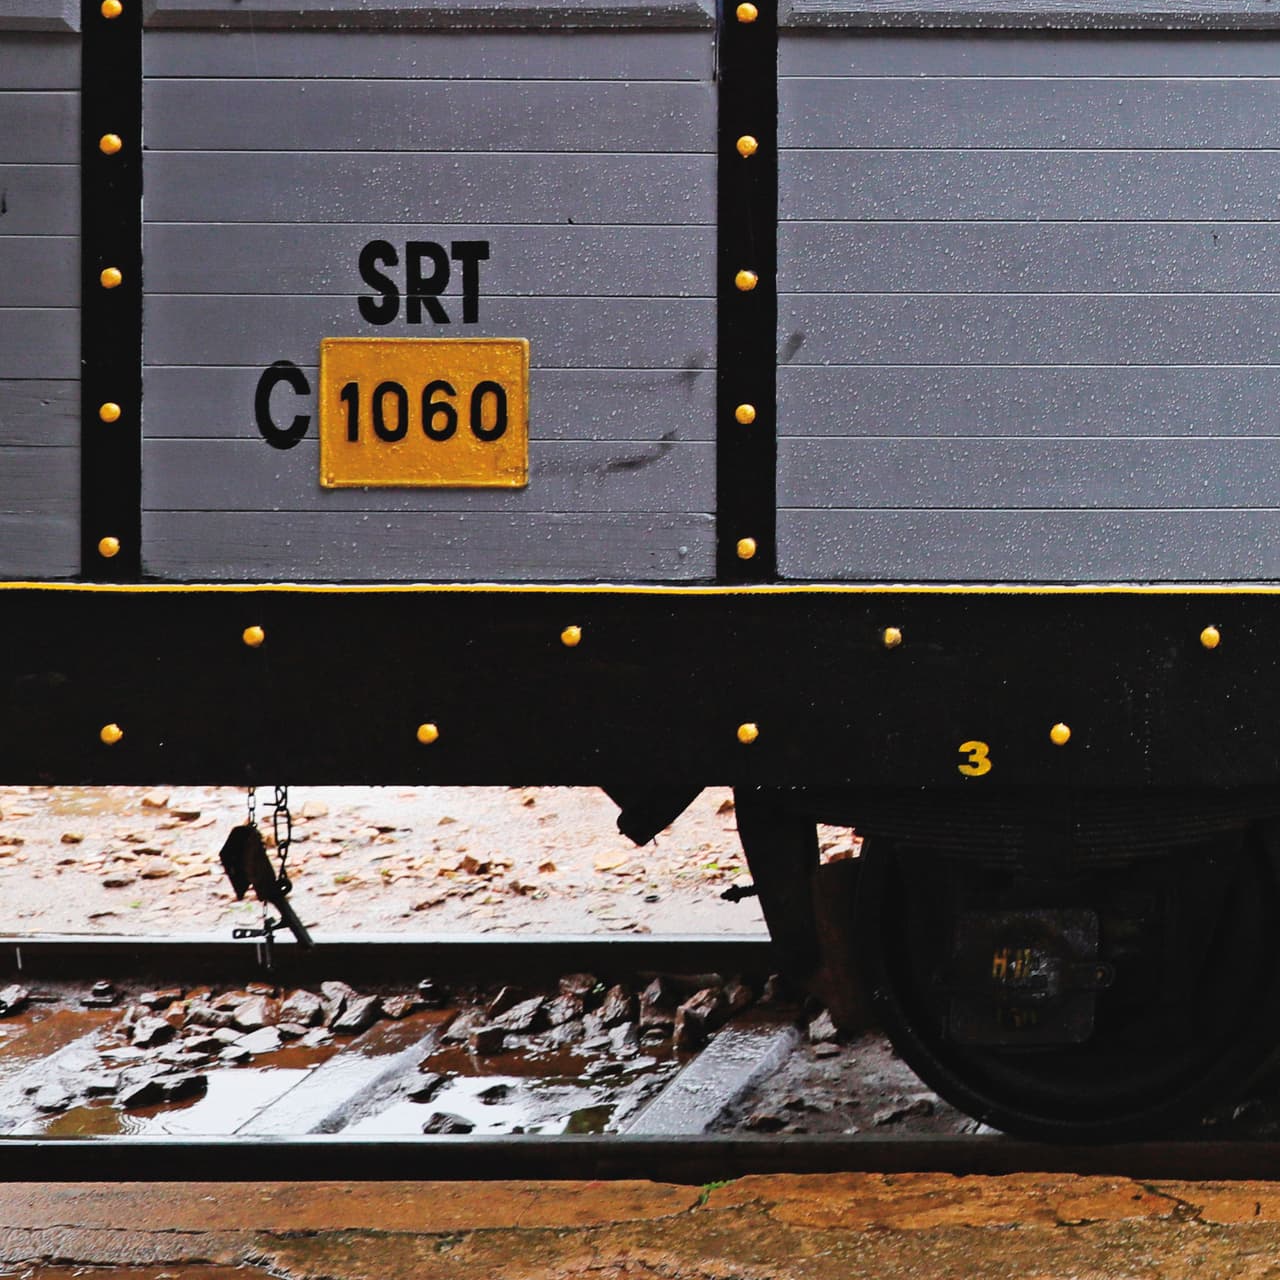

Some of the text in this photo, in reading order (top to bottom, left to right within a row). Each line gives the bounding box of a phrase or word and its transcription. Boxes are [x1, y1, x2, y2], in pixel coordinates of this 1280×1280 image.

[358, 239, 490, 326] SRT
[255, 359, 508, 450] C 1060
[958, 740, 992, 776] 3
